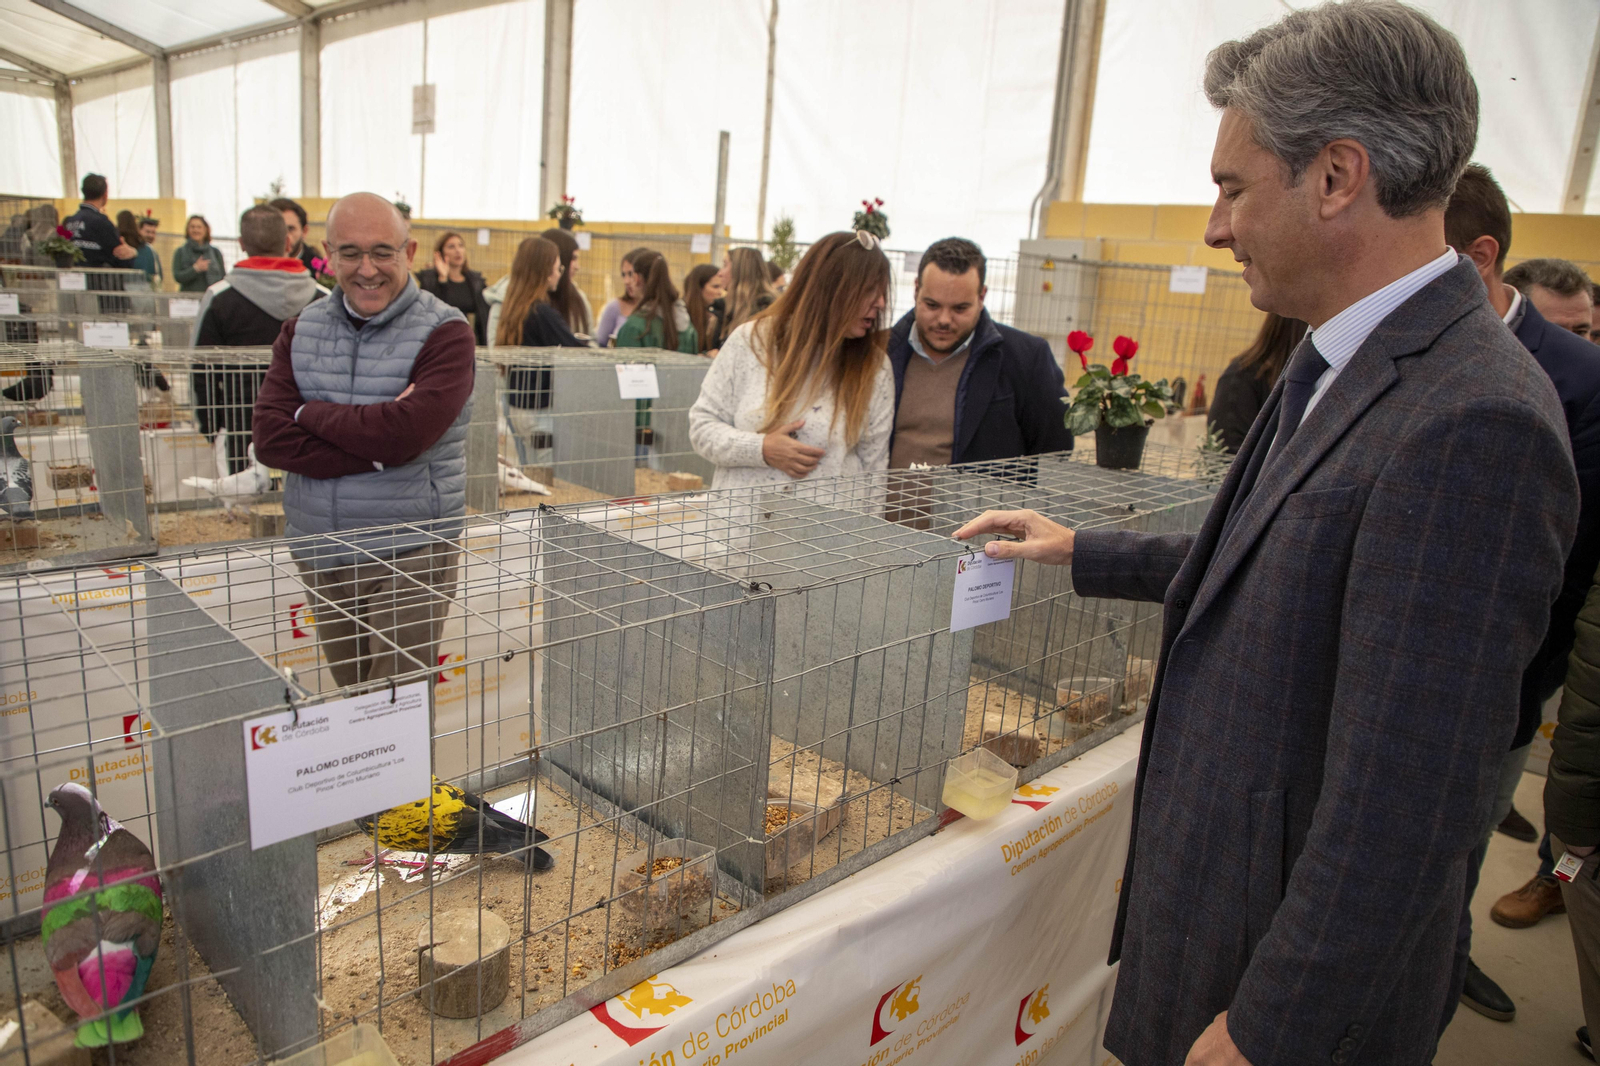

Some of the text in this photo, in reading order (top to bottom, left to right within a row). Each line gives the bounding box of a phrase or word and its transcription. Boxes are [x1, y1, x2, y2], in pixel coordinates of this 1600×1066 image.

[282, 716, 329, 732] Diputación
[295, 725, 330, 738] Córdoba
[349, 703, 422, 724] Centro Agropecuario Provincial
[288, 785, 303, 794] Club
[305, 776, 335, 790] Deportivo
[346, 761, 391, 777] Columbicultura
[296, 744, 396, 777] PALOMO DEPORTIVO
[337, 779, 354, 787] Cerro
[356, 771, 380, 782] Muriano
[1001, 781, 1119, 863] Diputación de Córdoba
[1011, 801, 1114, 876] Centro Agropecuario Provincial
[682, 1031, 710, 1059] de
[715, 979, 797, 1038] Córdoba
[725, 1009, 789, 1059] Provincial
[894, 1033, 912, 1052] de
[916, 991, 970, 1037] Córdoba
[917, 1011, 960, 1050] Provincial
